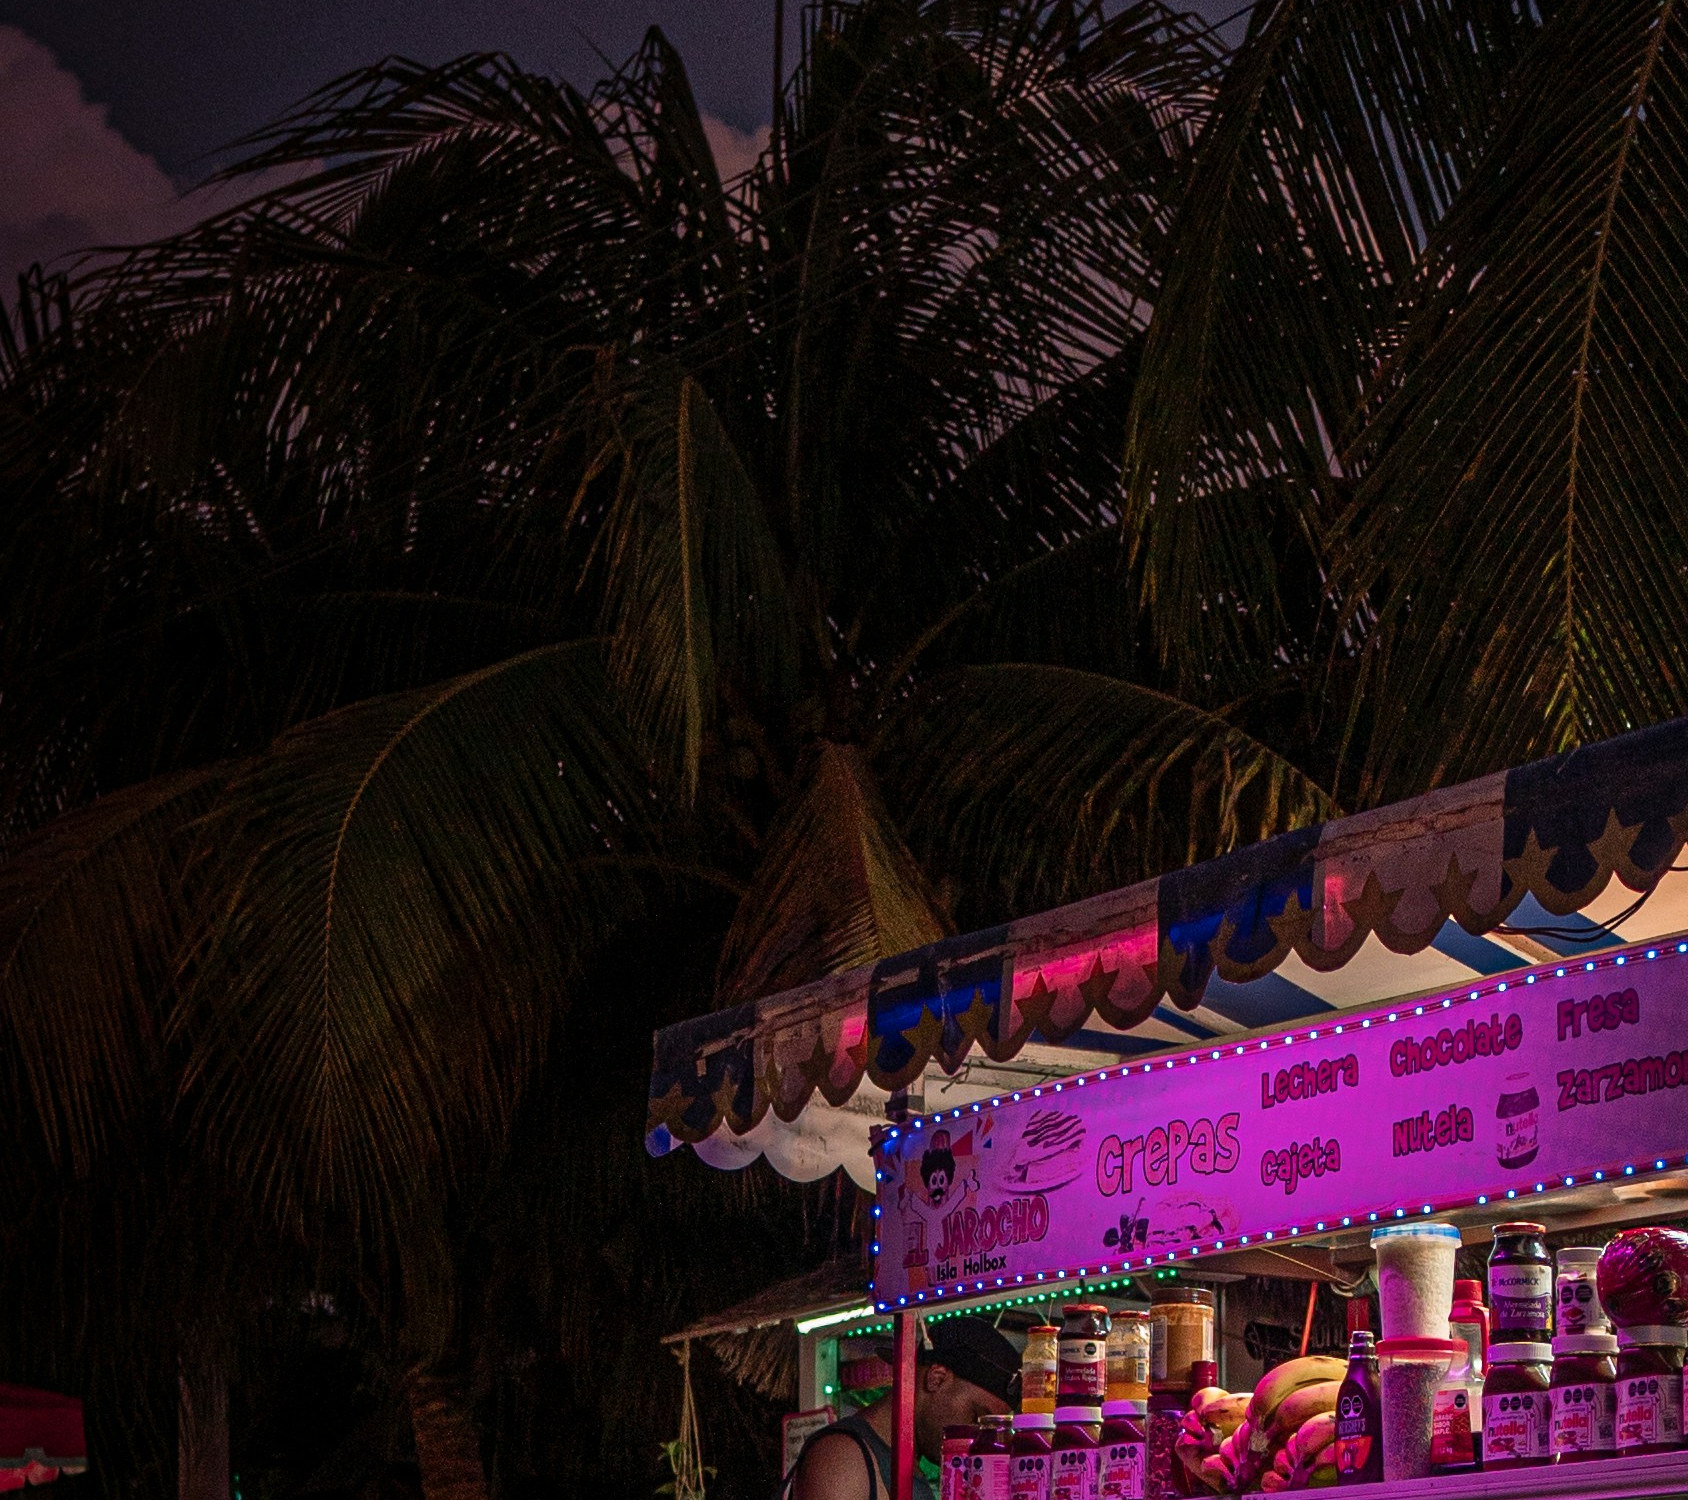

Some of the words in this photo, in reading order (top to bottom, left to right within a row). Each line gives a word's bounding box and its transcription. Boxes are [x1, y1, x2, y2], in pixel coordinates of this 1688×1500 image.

[1556, 987, 1640, 1042] Fresa
[1390, 1012, 1523, 1078] Chocolate
[1261, 1053, 1360, 1109] Lechera
[1392, 1103, 1474, 1157] Nutela
[934, 1195, 1050, 1263] JAROCHO
[936, 1261, 957, 1282] Isla
[963, 1255, 1008, 1276] Holbox
[1488, 1421, 1527, 1438] nutella
[1554, 1413, 1589, 1431] nutella
[1618, 1407, 1653, 1425] nutella
